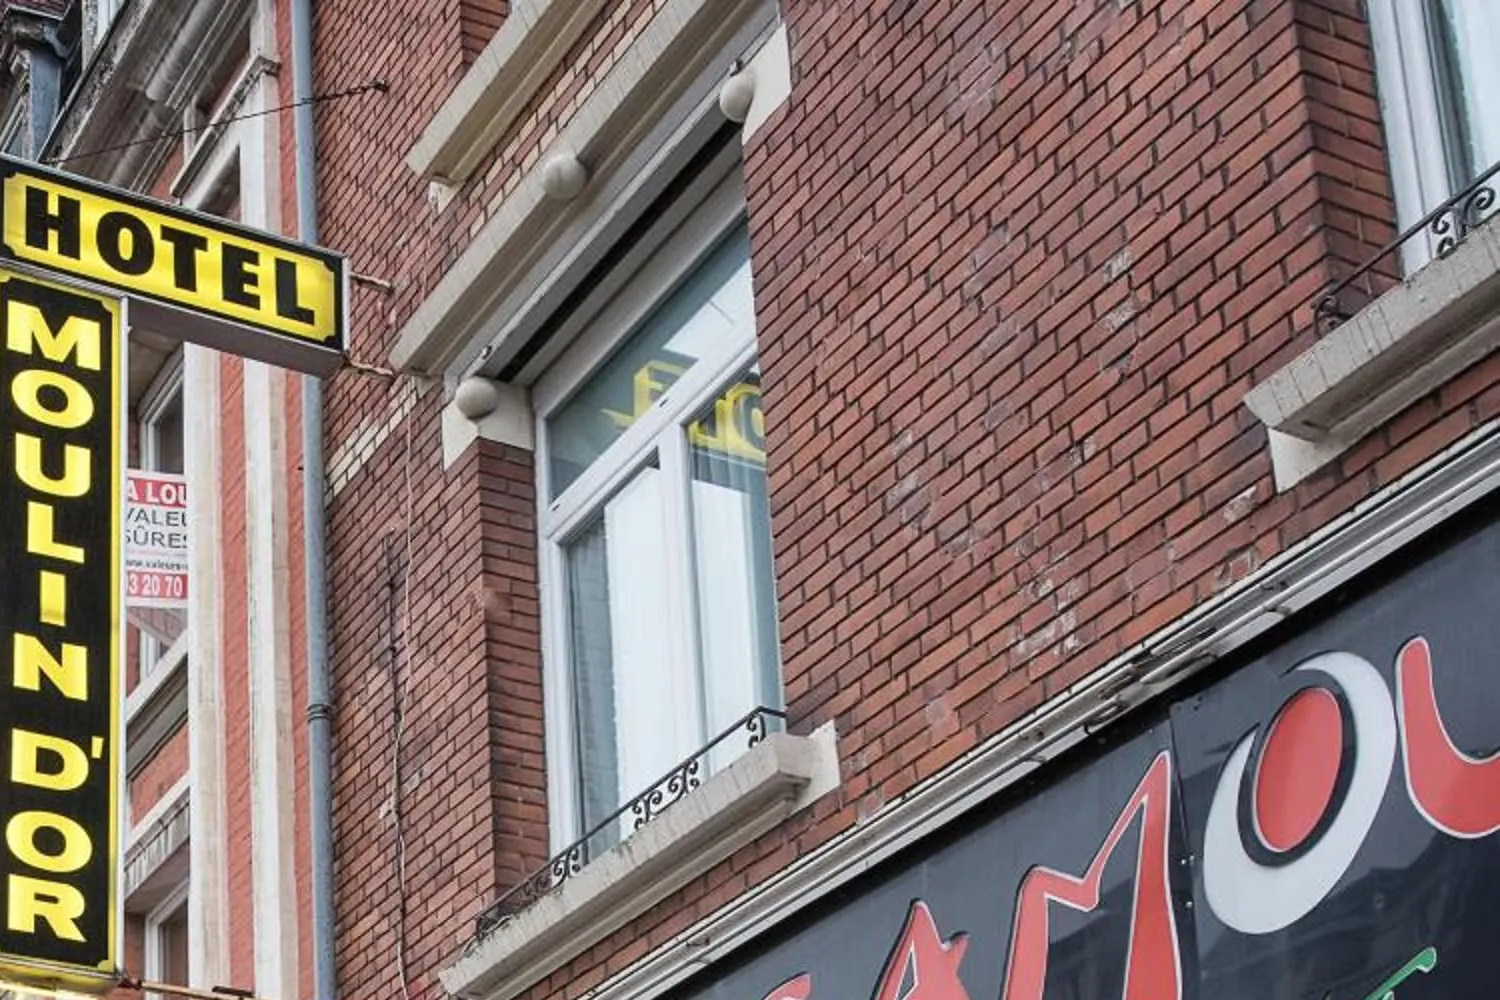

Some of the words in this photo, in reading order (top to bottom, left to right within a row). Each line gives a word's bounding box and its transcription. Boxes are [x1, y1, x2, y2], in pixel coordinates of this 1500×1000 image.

[24, 186, 316, 326] HOTEL
[6, 300, 101, 701] MOULIN
[142, 574, 160, 595] 20
[165, 576, 183, 597] 70
[5, 728, 104, 943] D'OR
